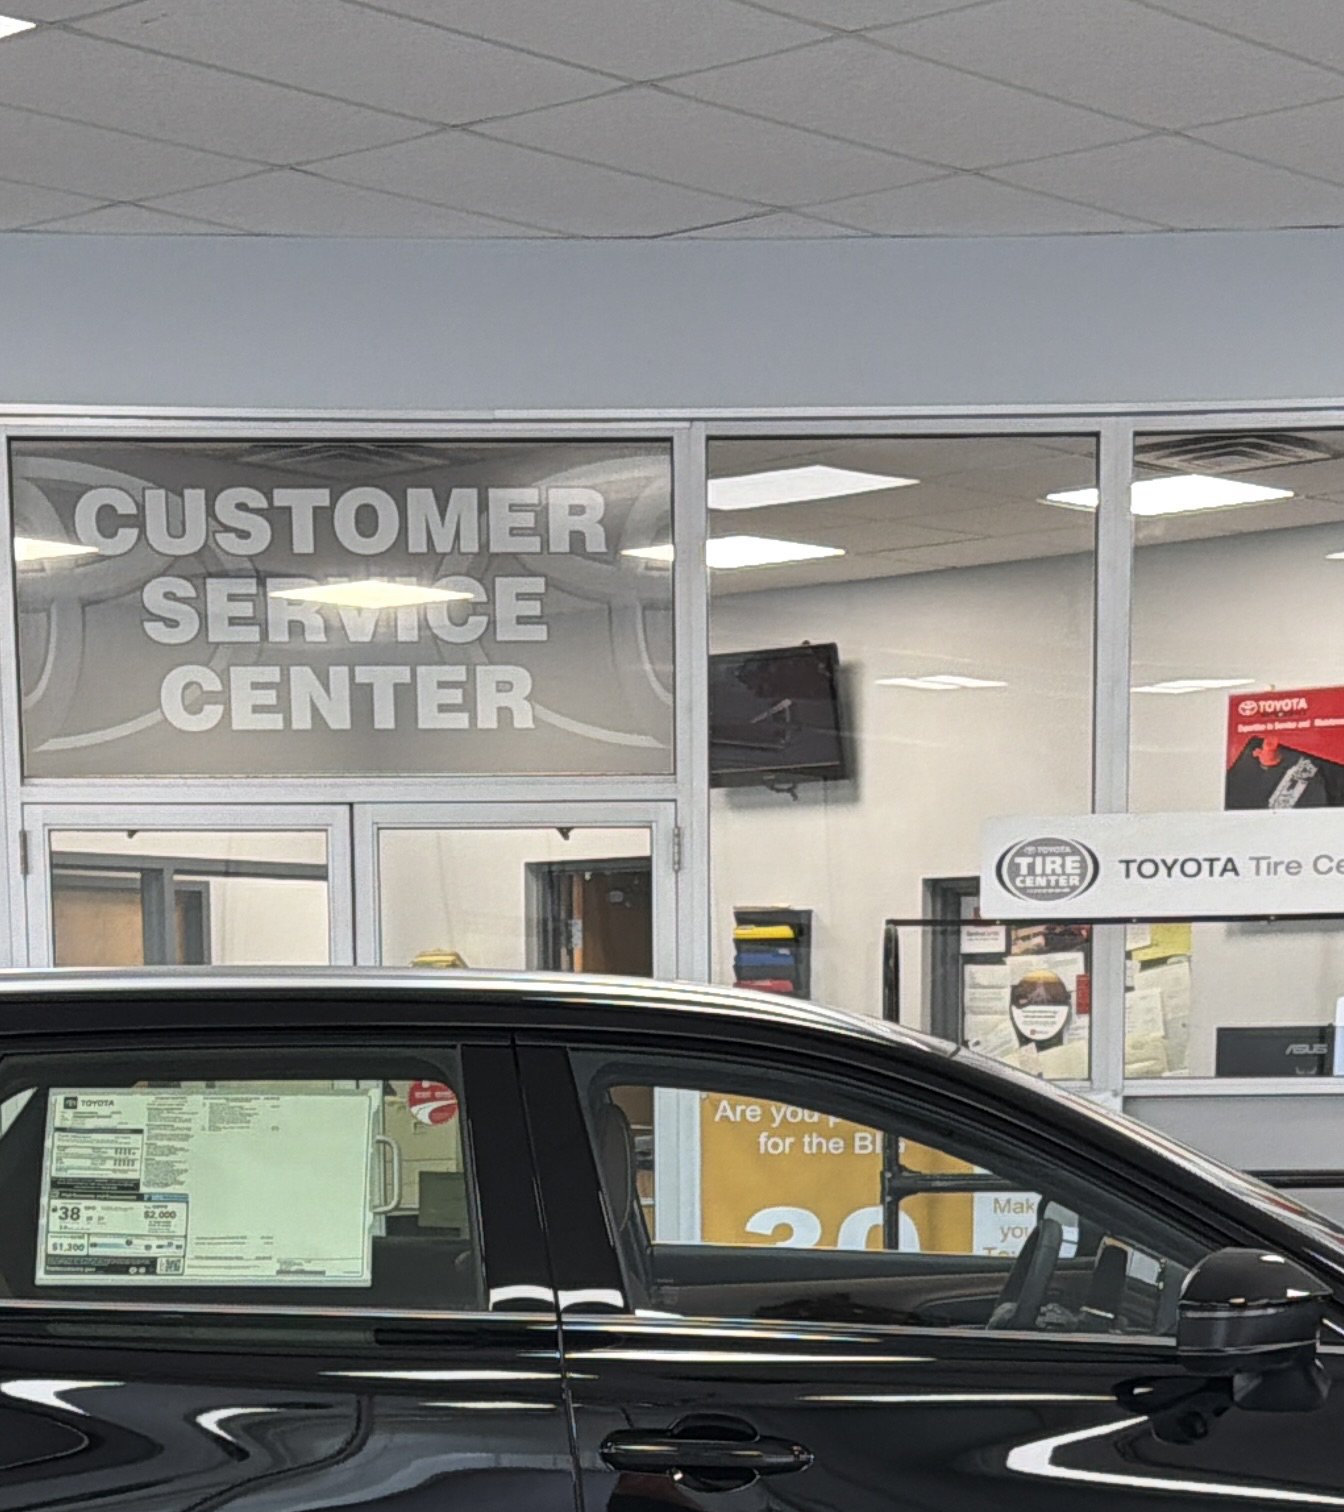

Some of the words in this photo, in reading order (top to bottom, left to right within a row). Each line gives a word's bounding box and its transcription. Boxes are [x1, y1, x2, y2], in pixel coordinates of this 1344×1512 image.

[74, 486, 608, 557] CUSTOMER
[141, 574, 549, 645] SERVICE
[160, 664, 536, 733] CENTER
[1258, 697, 1308, 713] TOYOTA
[1014, 855, 1081, 875] TIRE
[1118, 856, 1240, 880] TOYOTA
[1249, 854, 1303, 877] Tire
[1015, 875, 1080, 888] CENTER
[1285, 1043, 1328, 1056] ASUS
[81, 1099, 115, 1108] TOYOTA
[714, 1100, 762, 1123] Are
[759, 1132, 794, 1155] for
[804, 1132, 844, 1155] the
[58, 1205, 81, 1221] 38
[144, 1210, 177, 1220] $2,000
